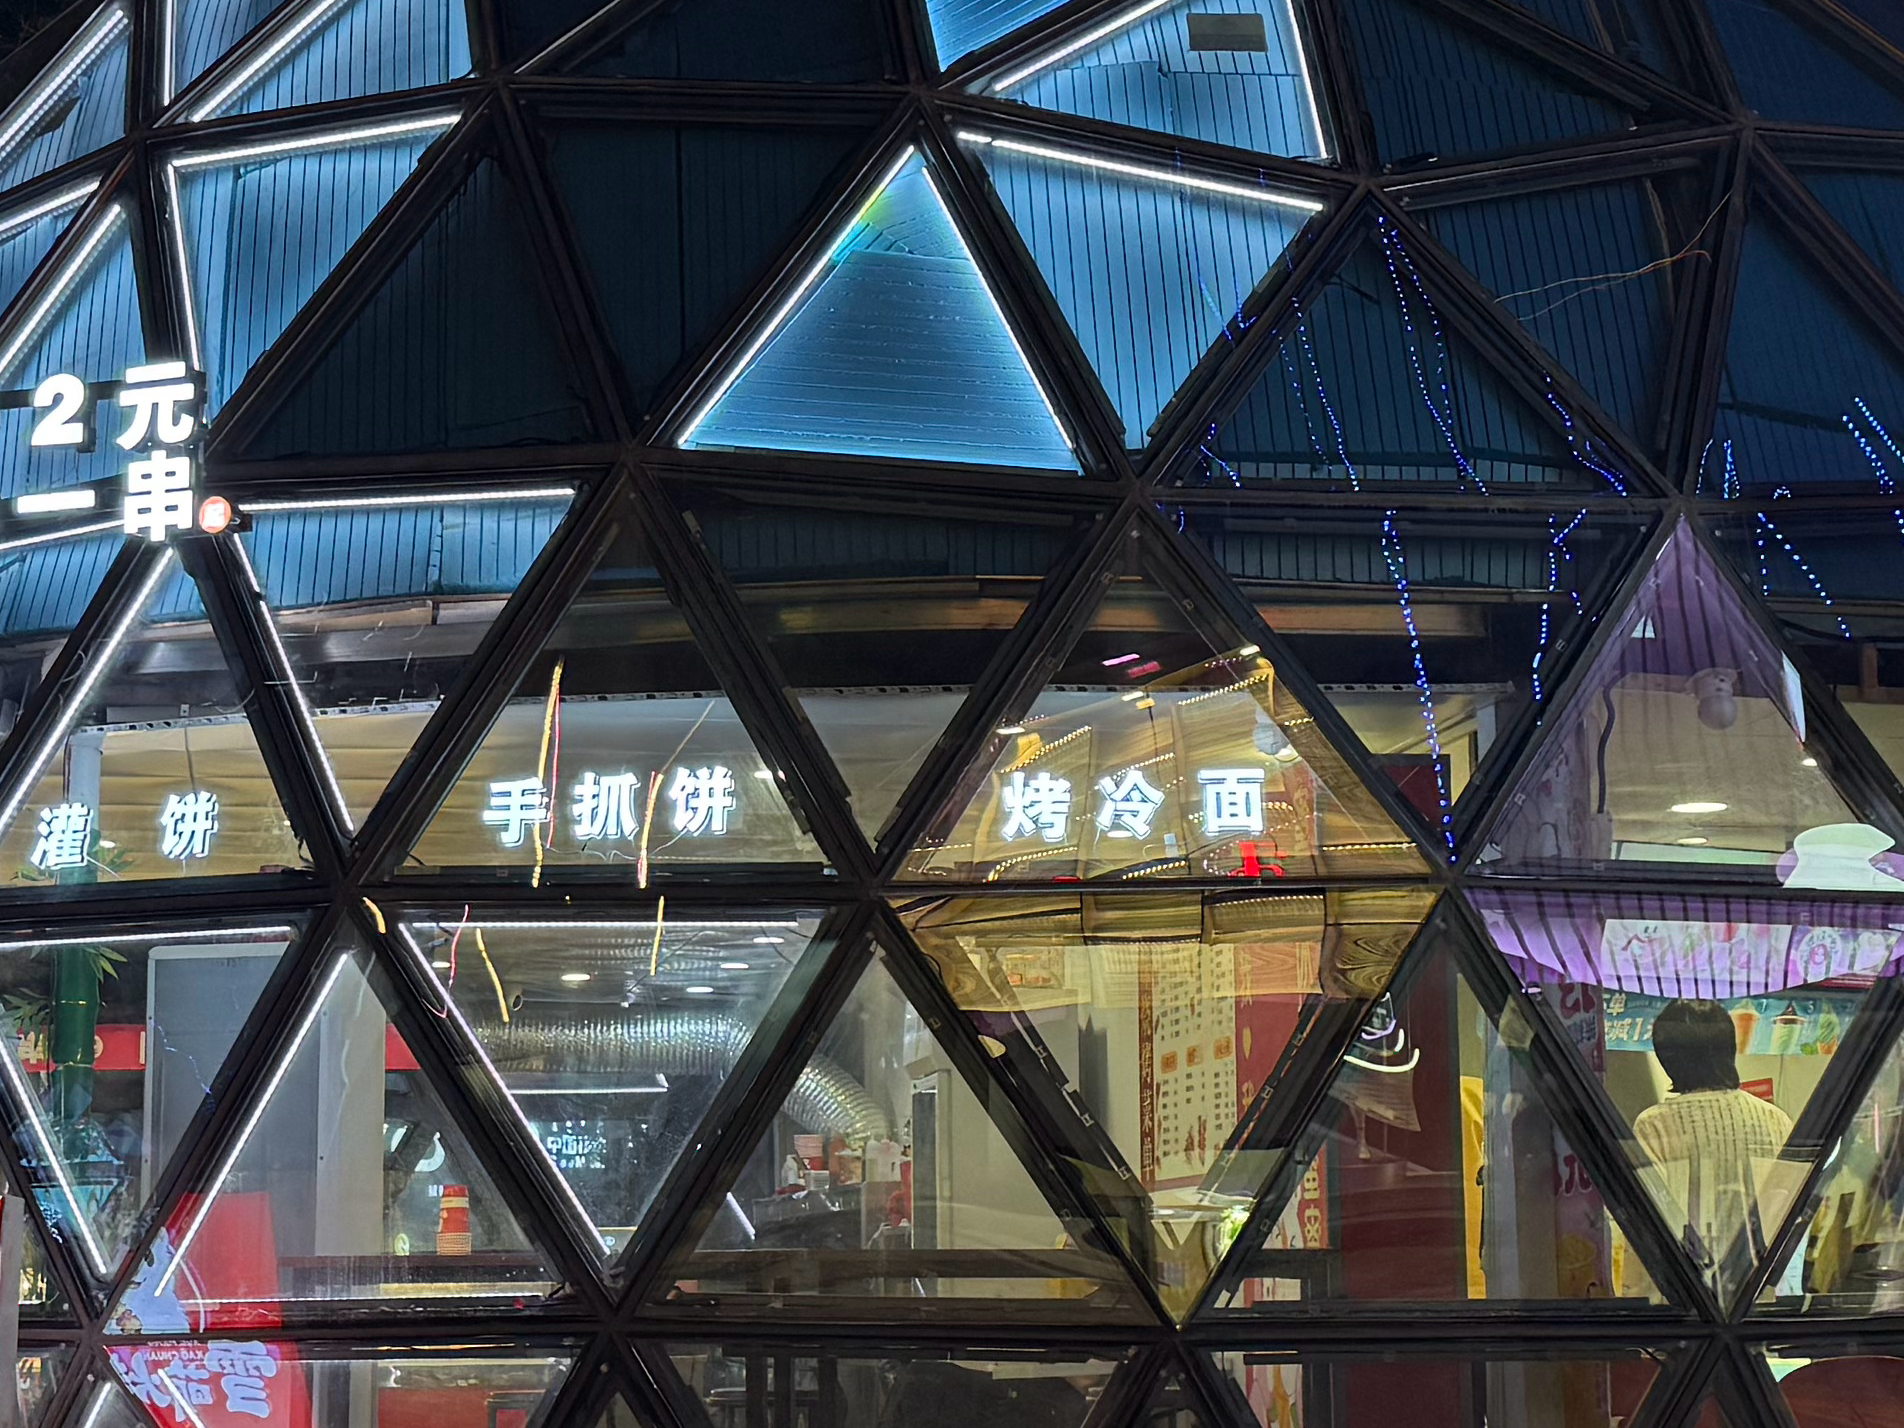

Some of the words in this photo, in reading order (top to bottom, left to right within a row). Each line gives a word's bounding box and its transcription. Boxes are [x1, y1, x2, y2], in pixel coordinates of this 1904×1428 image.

[483, 766, 737, 848] 手抓饼
[1001, 768, 1266, 842] 烤冷面
